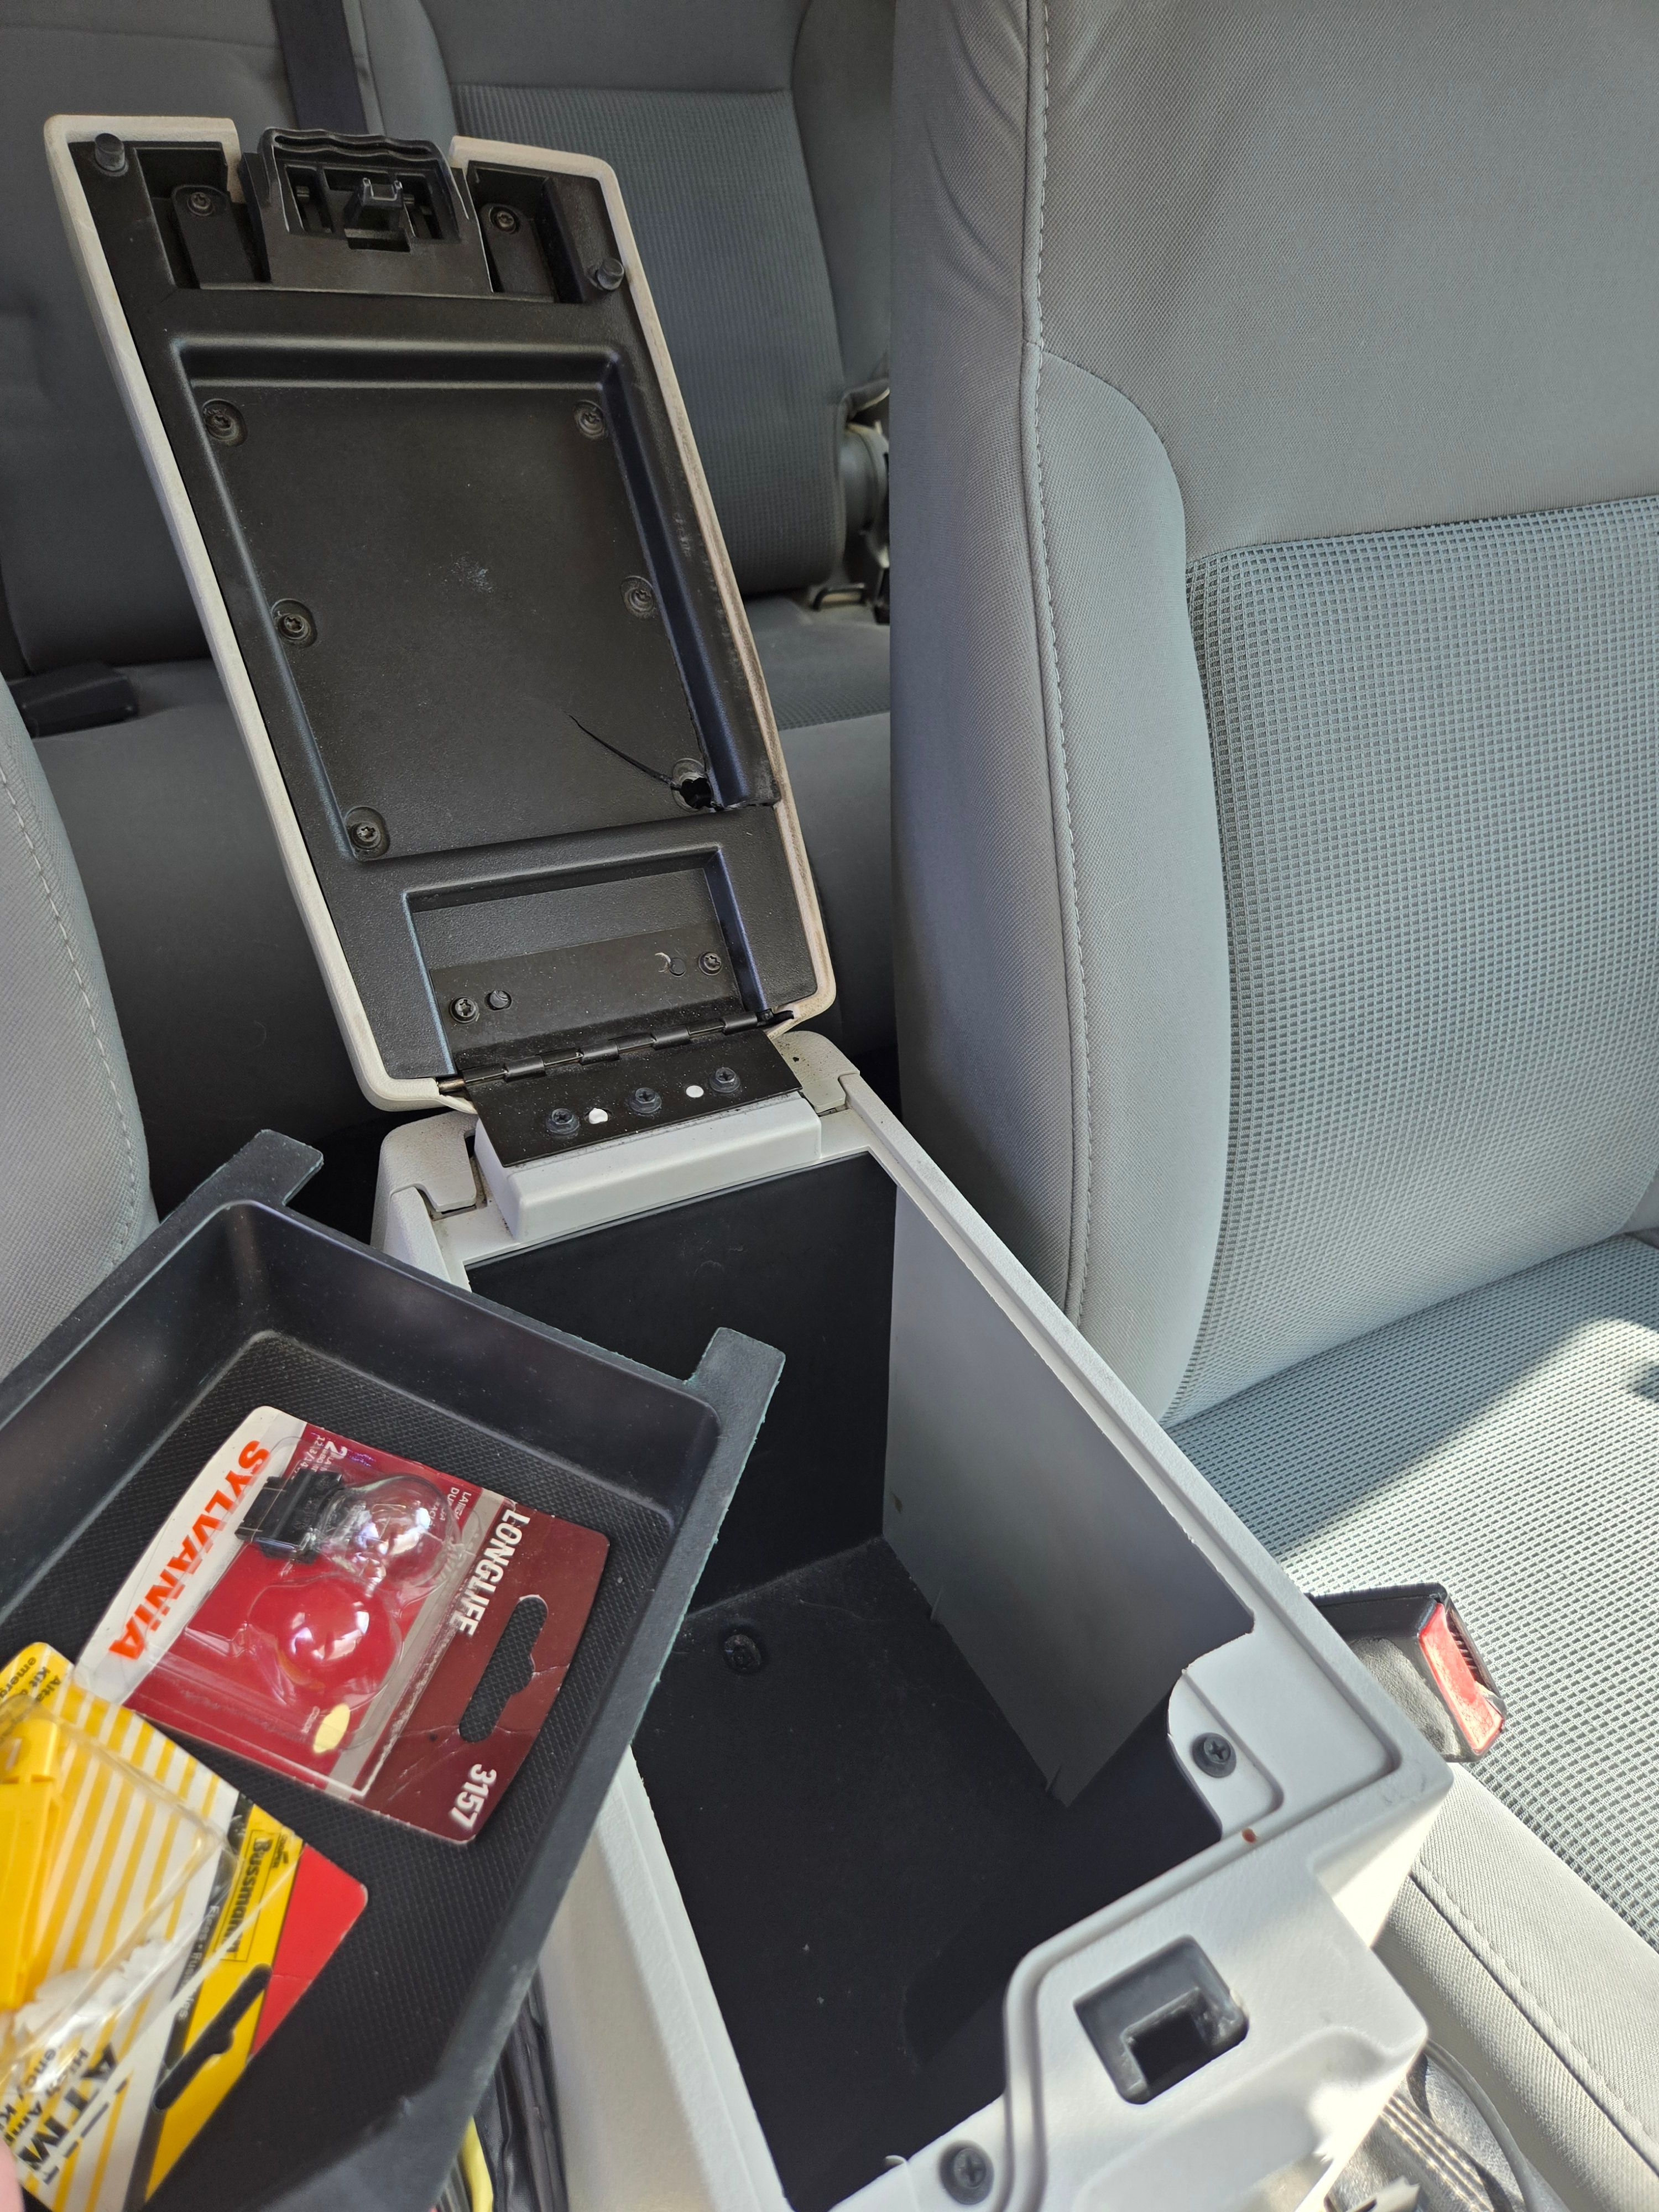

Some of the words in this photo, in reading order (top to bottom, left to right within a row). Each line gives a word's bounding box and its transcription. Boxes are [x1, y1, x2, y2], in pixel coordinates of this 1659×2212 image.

[325, 1441, 348, 1459] 2
[108, 1440, 270, 1660] SYLVANIA
[451, 1763, 497, 1828] 3157
[17, 2042, 119, 2173] ATM
